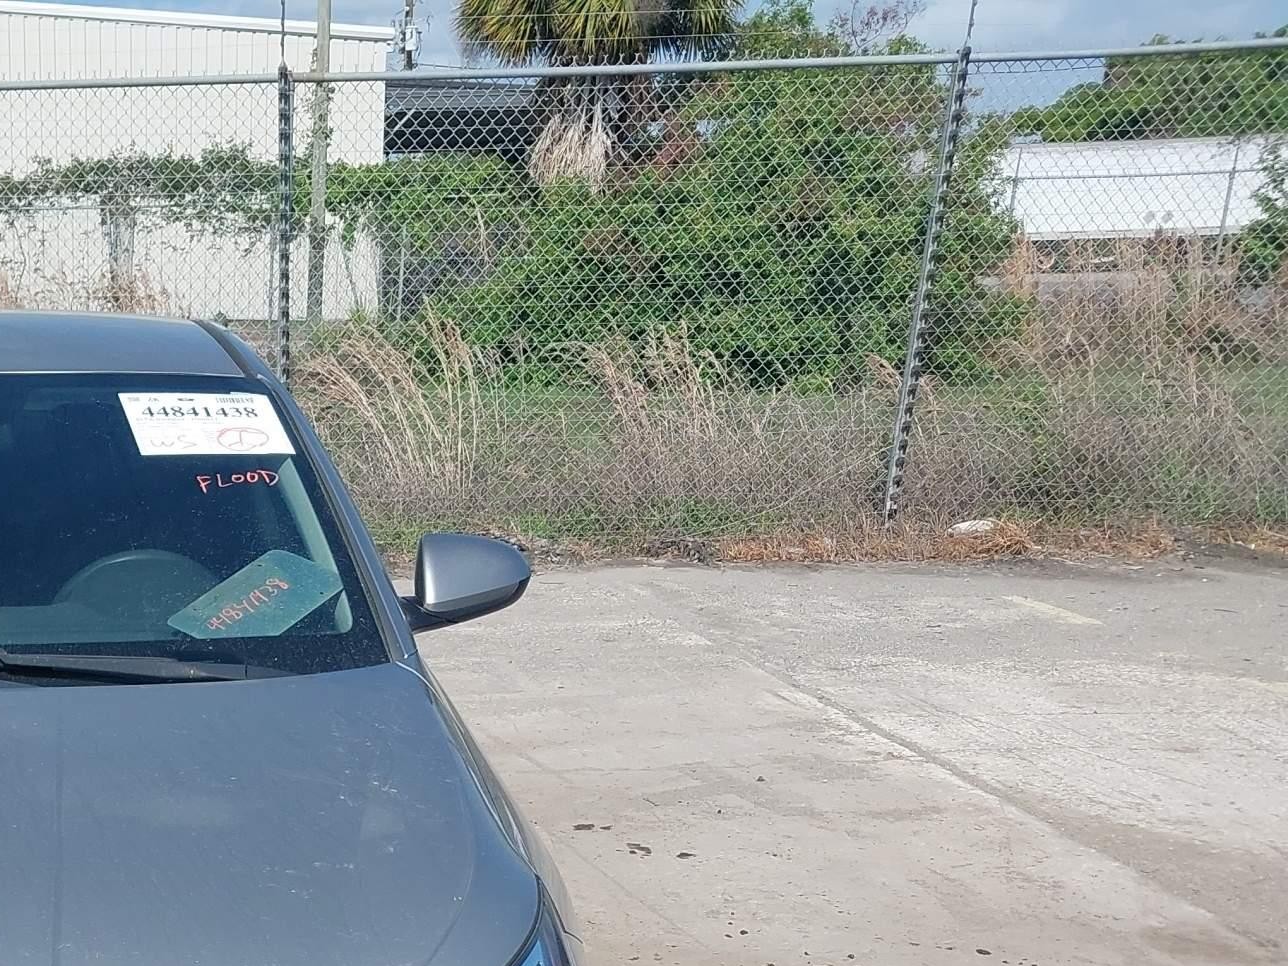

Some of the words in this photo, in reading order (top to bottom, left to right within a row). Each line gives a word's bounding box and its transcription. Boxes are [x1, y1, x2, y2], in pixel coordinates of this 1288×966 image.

[142, 405, 259, 418] 44841438
[196, 469, 280, 494] FLOOD
[206, 577, 289, 630] 44841438
